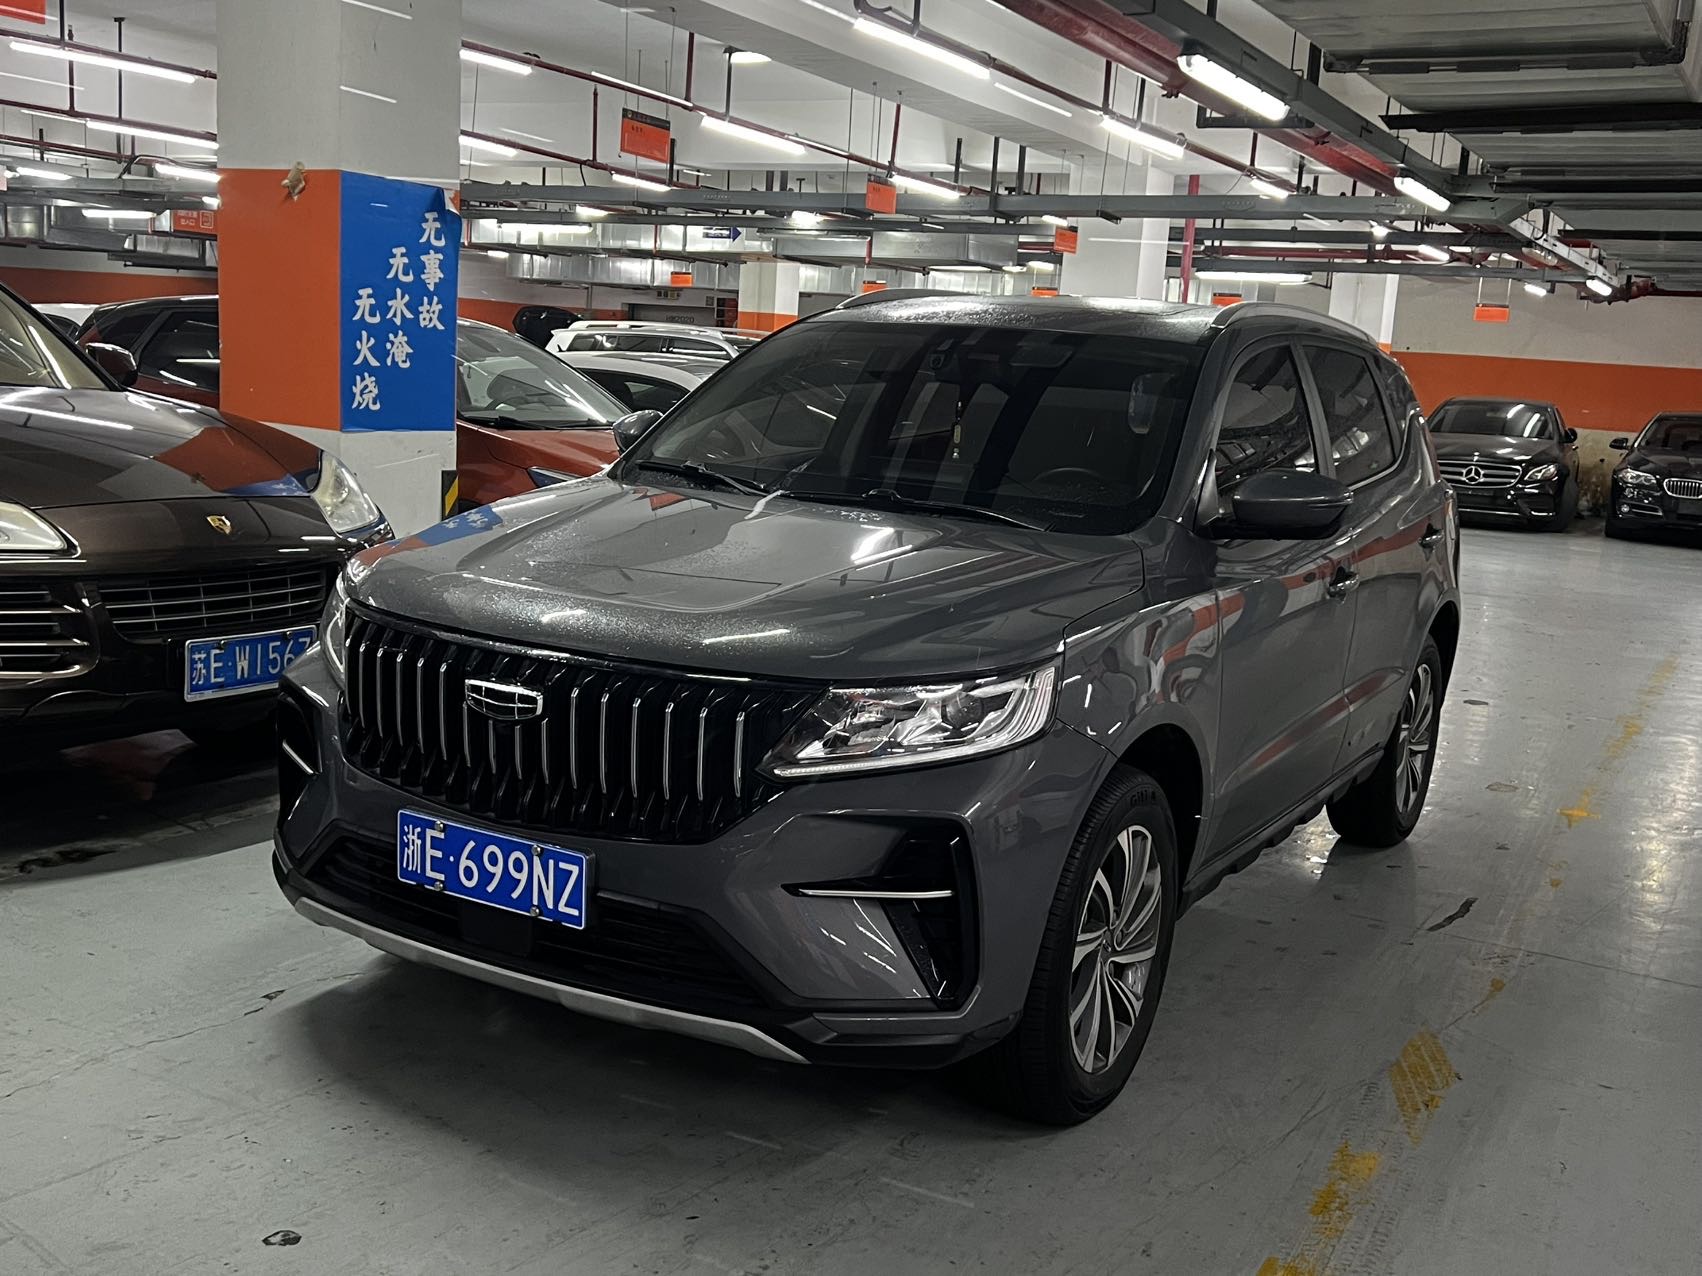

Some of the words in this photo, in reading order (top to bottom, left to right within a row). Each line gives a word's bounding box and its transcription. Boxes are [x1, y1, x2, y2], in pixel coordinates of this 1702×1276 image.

[386, 246, 414, 368] 无水淹
[418, 211, 446, 330] 无事故
[352, 287, 381, 411] 无火烧
[402, 824, 580, 917] 浙E·699NZ
